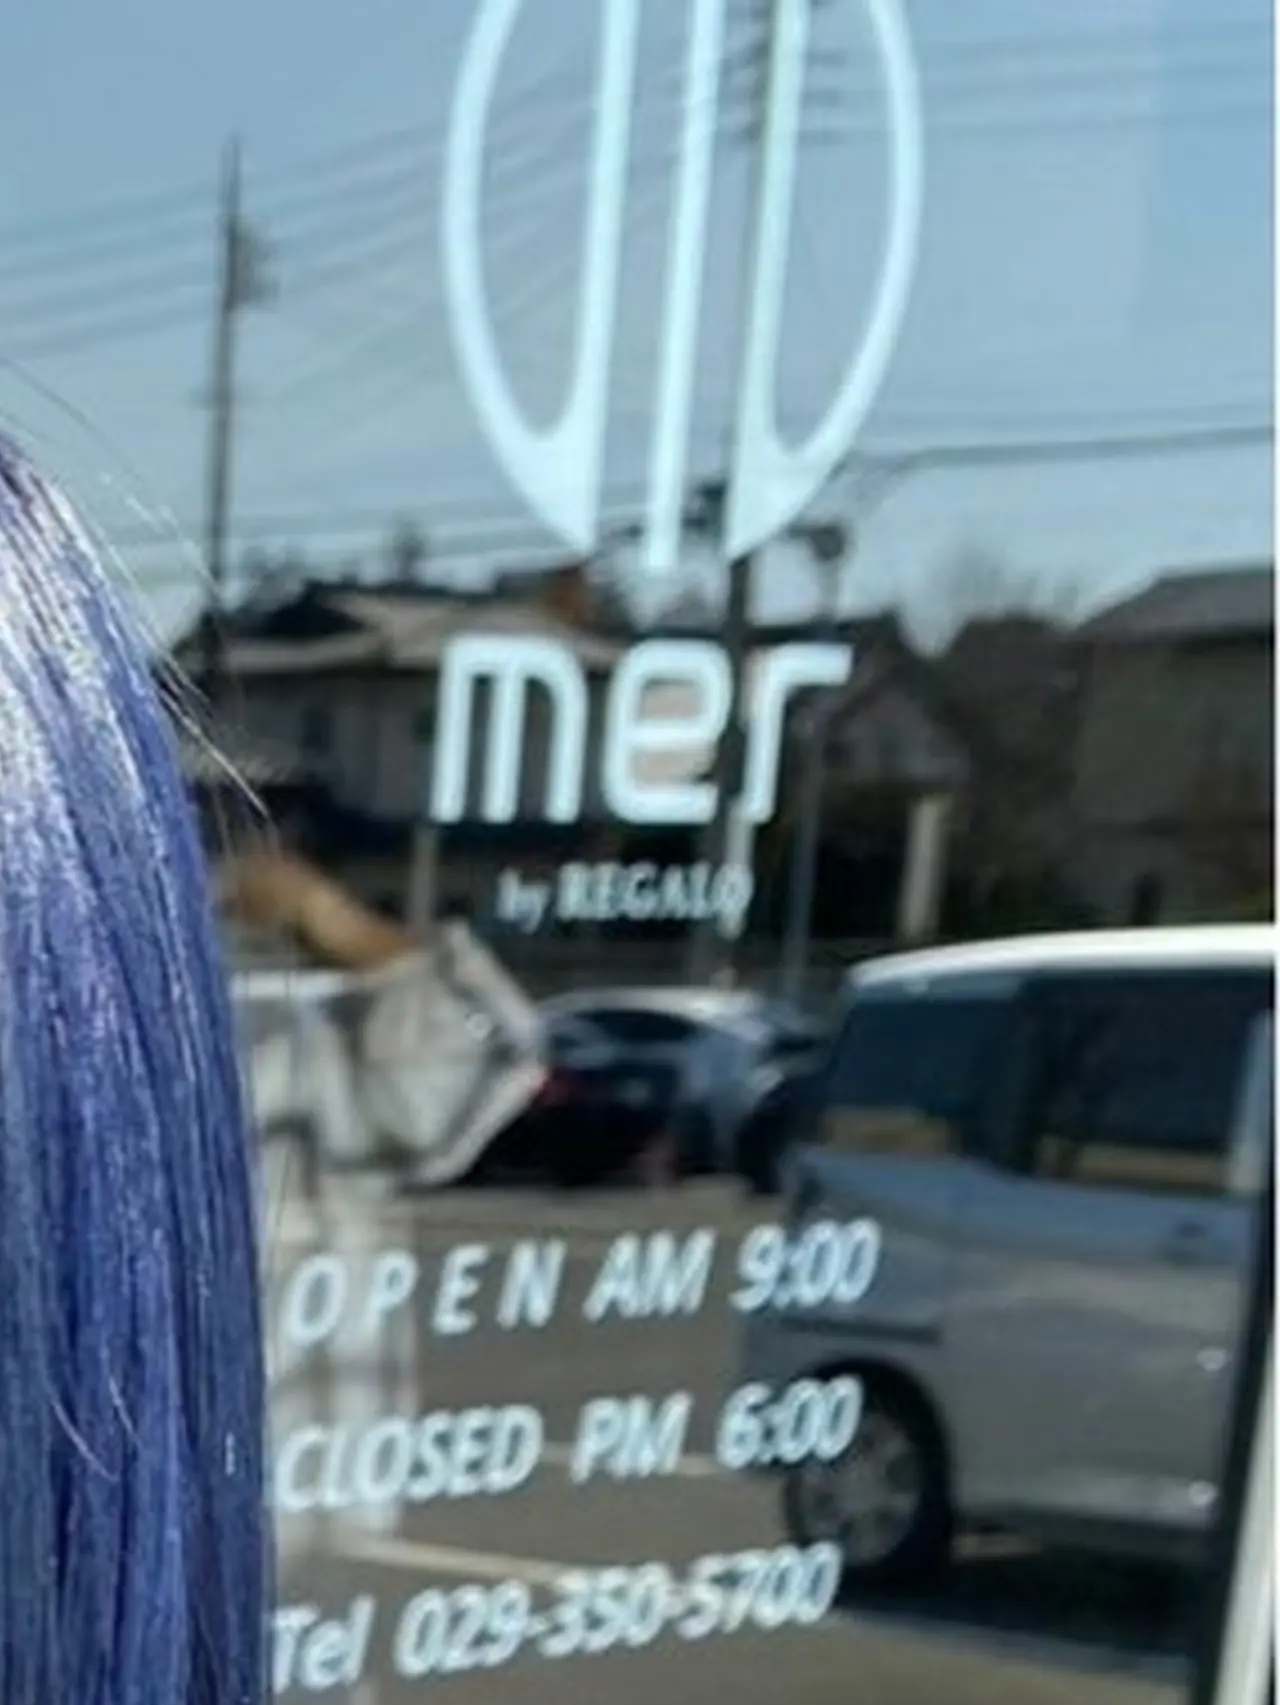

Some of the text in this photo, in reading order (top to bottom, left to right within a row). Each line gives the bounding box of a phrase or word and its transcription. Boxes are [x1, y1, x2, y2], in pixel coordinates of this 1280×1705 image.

[429, 634, 853, 826] mer
[497, 860, 754, 934] by REGALO
[282, 1219, 882, 1346] OPEN AM 9:00
[276, 1376, 863, 1511] CLOSED PM 6:00
[272, 1541, 842, 1693] Tel 029-350-5700
